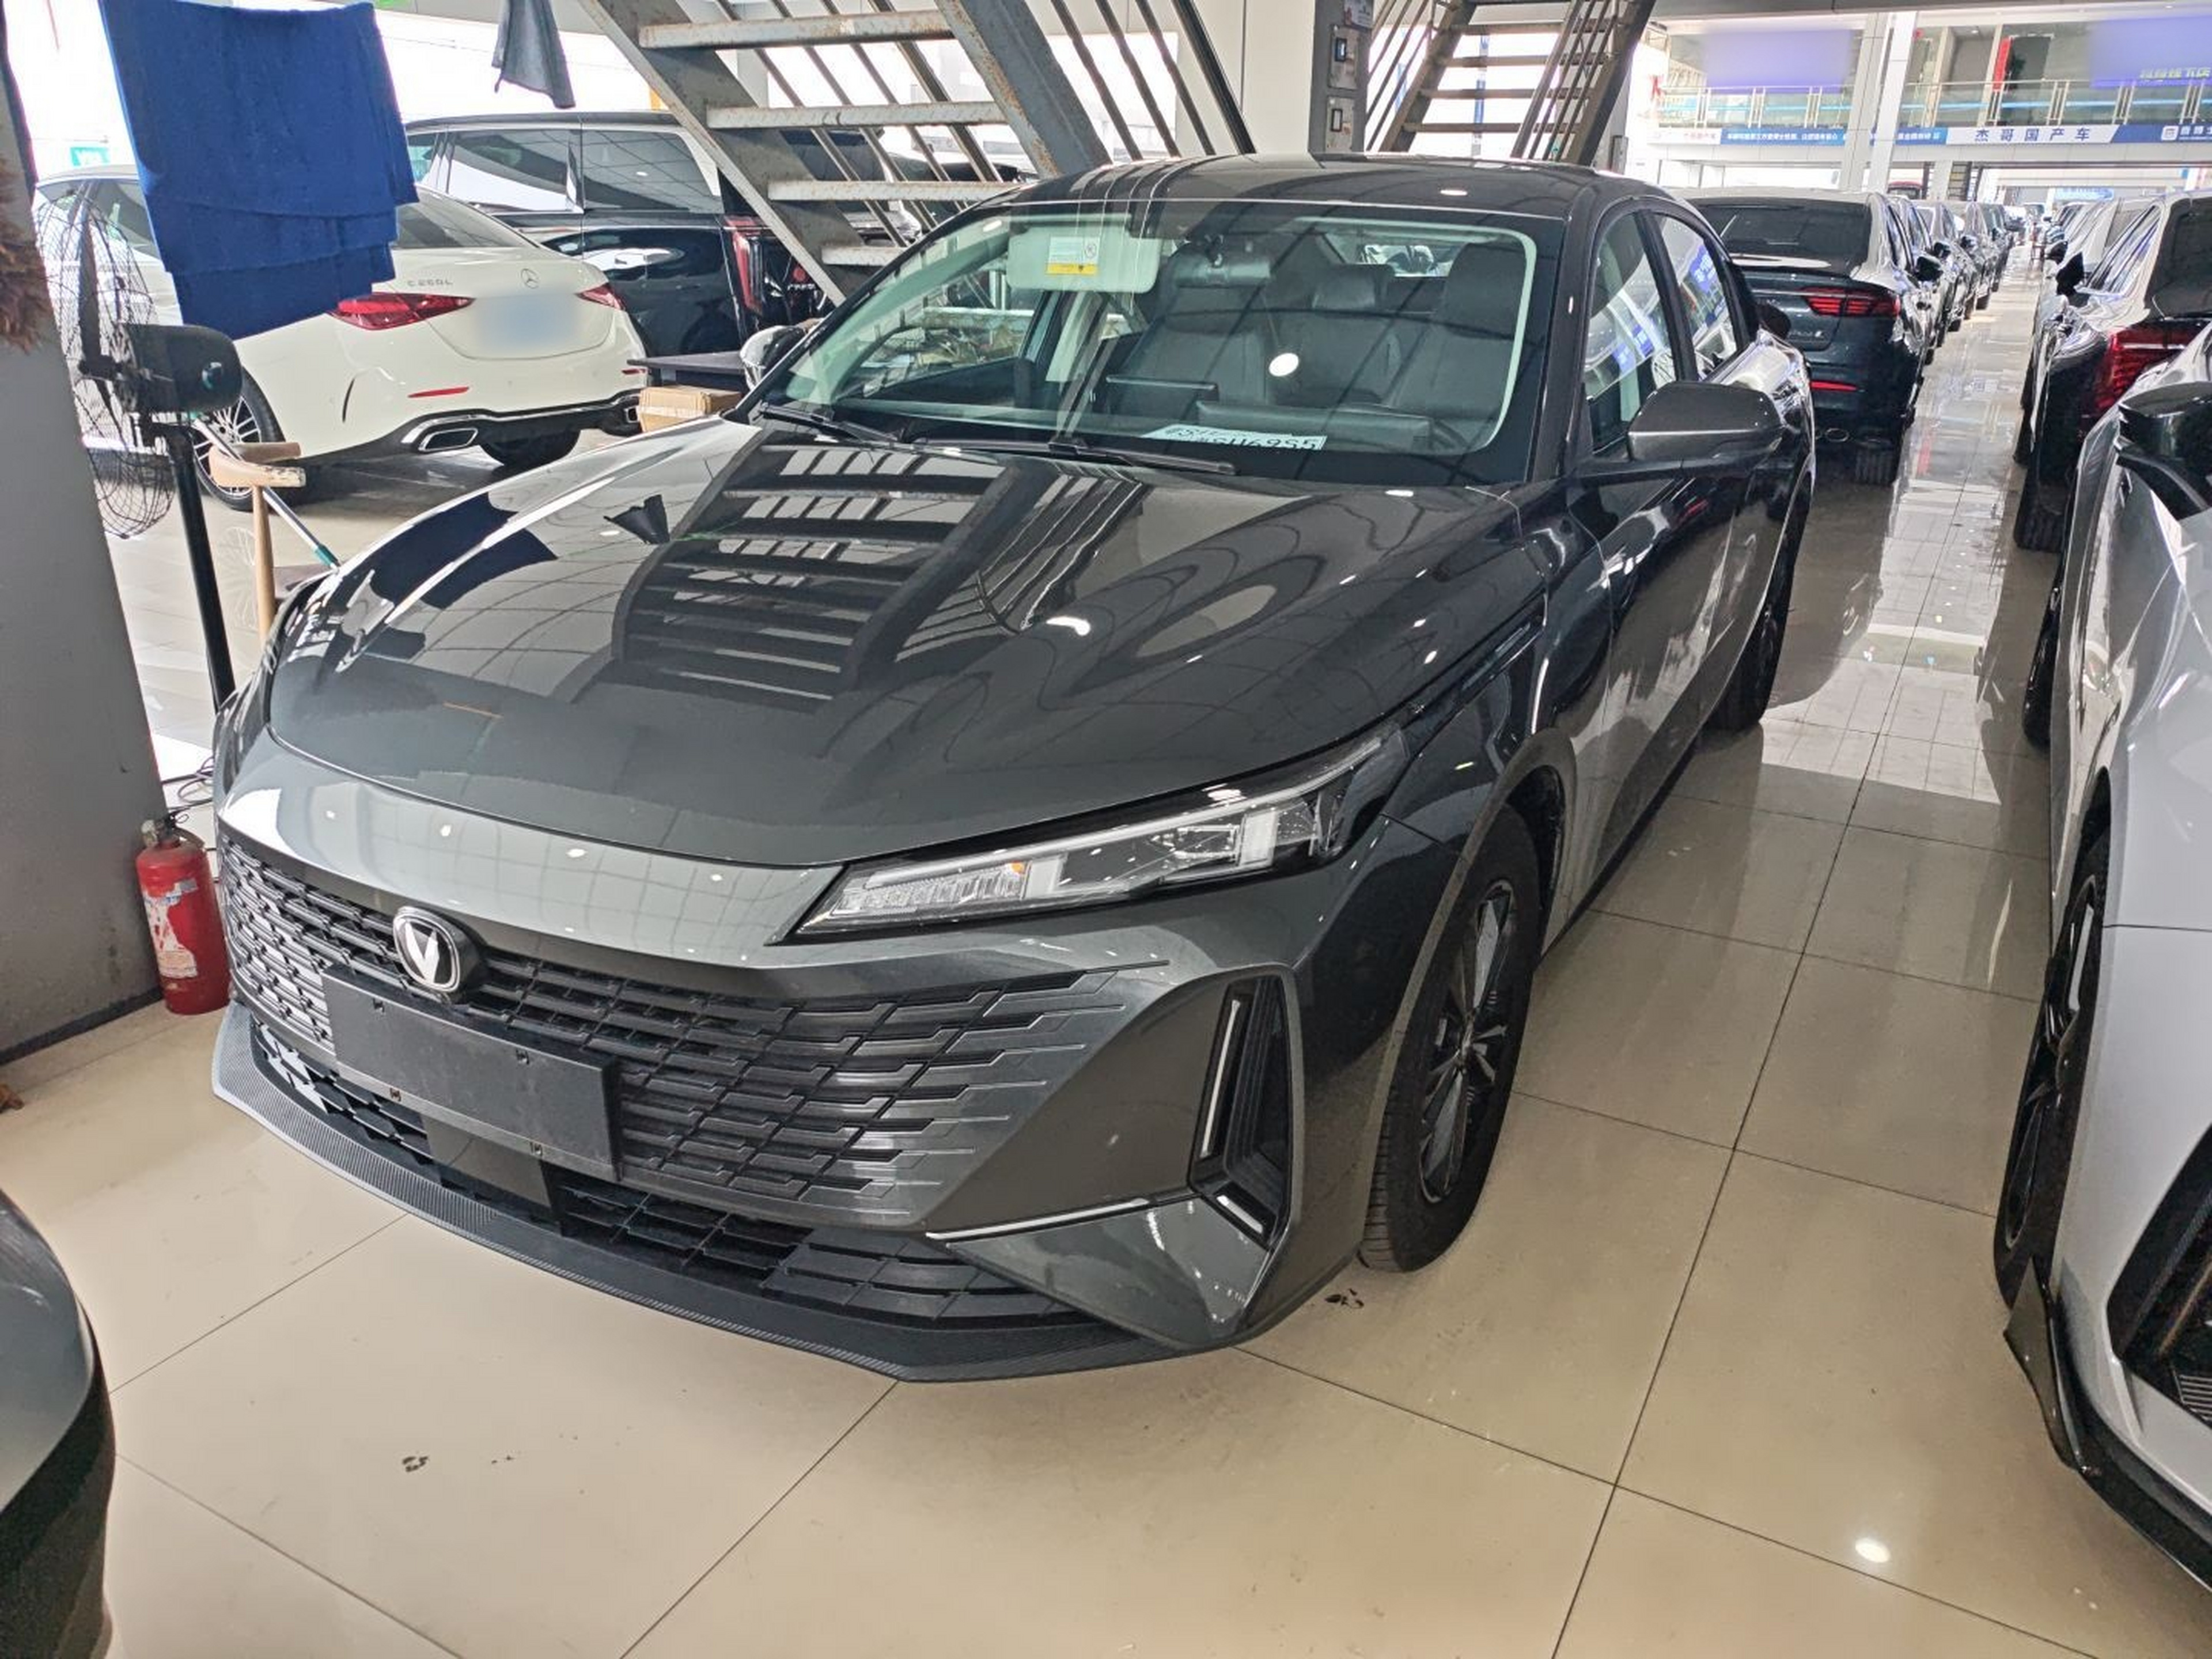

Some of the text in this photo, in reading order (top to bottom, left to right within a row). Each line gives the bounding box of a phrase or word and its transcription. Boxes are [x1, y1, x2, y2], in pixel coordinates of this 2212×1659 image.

[1975, 128, 2090, 141] 杰哥国产车
